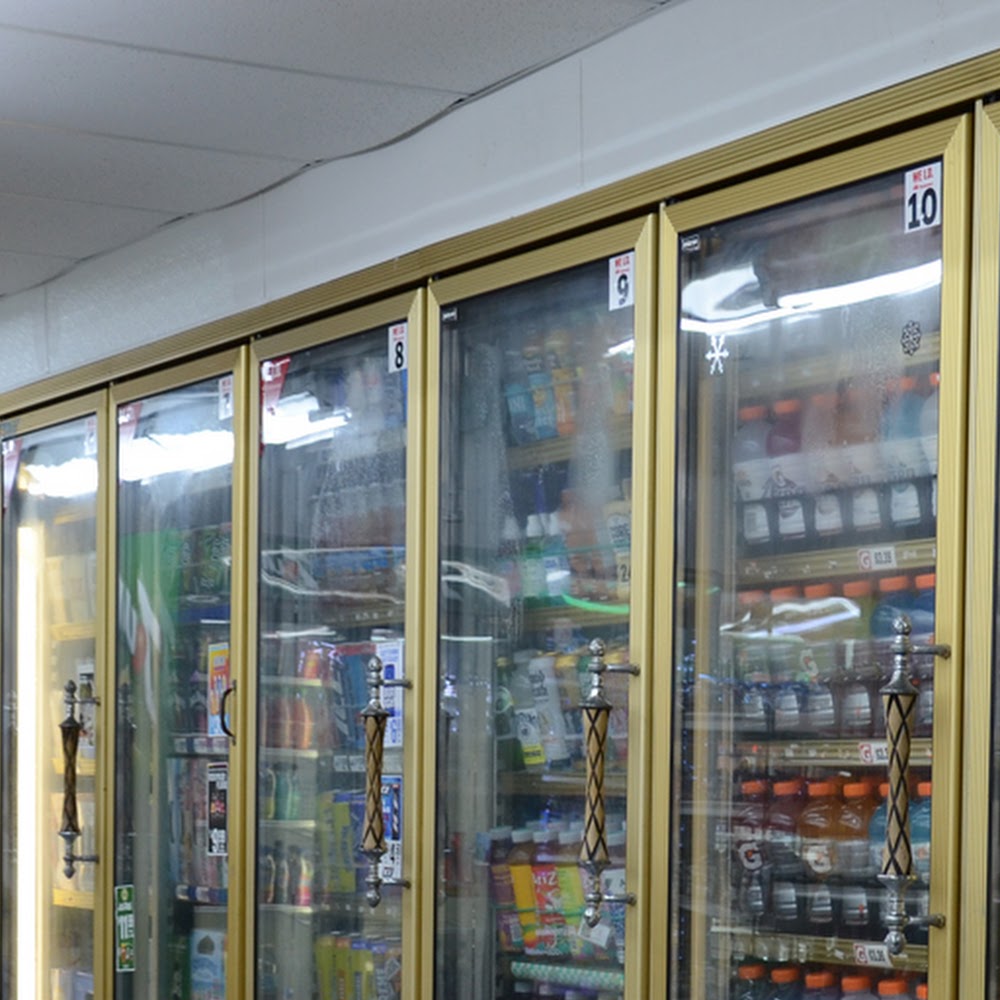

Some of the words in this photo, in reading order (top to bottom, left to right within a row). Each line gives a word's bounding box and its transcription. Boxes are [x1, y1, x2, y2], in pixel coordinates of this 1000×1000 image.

[908, 188, 937, 229] 10
[617, 273, 629, 305] 9
[395, 341, 404, 369] 8
